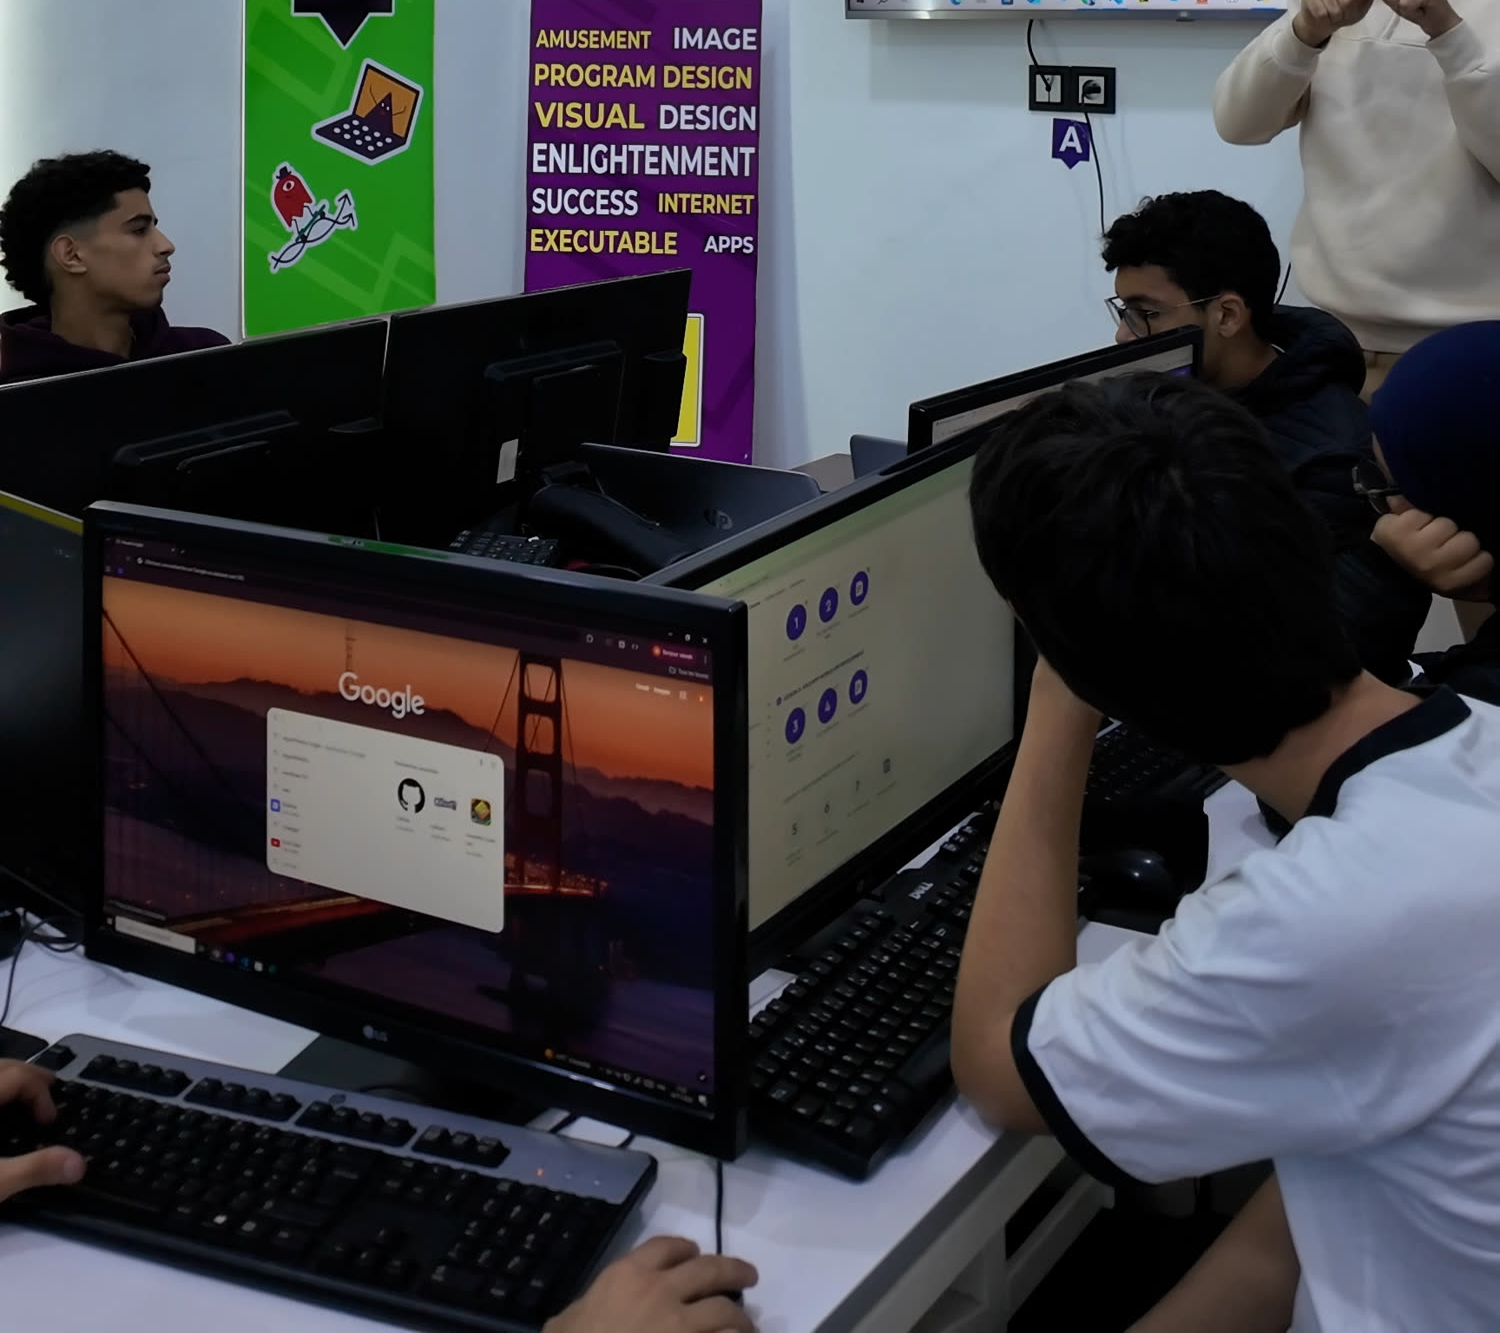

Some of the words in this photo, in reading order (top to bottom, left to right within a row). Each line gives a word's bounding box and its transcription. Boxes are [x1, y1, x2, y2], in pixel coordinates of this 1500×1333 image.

[536, 30, 651, 49] AMUSEMENT
[674, 27, 757, 50] IMAGE
[534, 64, 655, 87] PROGRAM
[663, 66, 751, 89] DESIGN
[535, 102, 645, 129] VISUAL
[659, 105, 756, 131] DESIGN
[1059, 126, 1083, 153] A
[532, 143, 755, 176] ENLIGHTENMENT
[532, 188, 638, 215] SUCCESS
[658, 193, 754, 214] INTERNET
[530, 229, 678, 254] EXECUTABLE
[704, 236, 754, 253] APPS
[825, 600, 832, 611] 2
[338, 672, 425, 718] Google
[792, 720, 798, 732] 3
